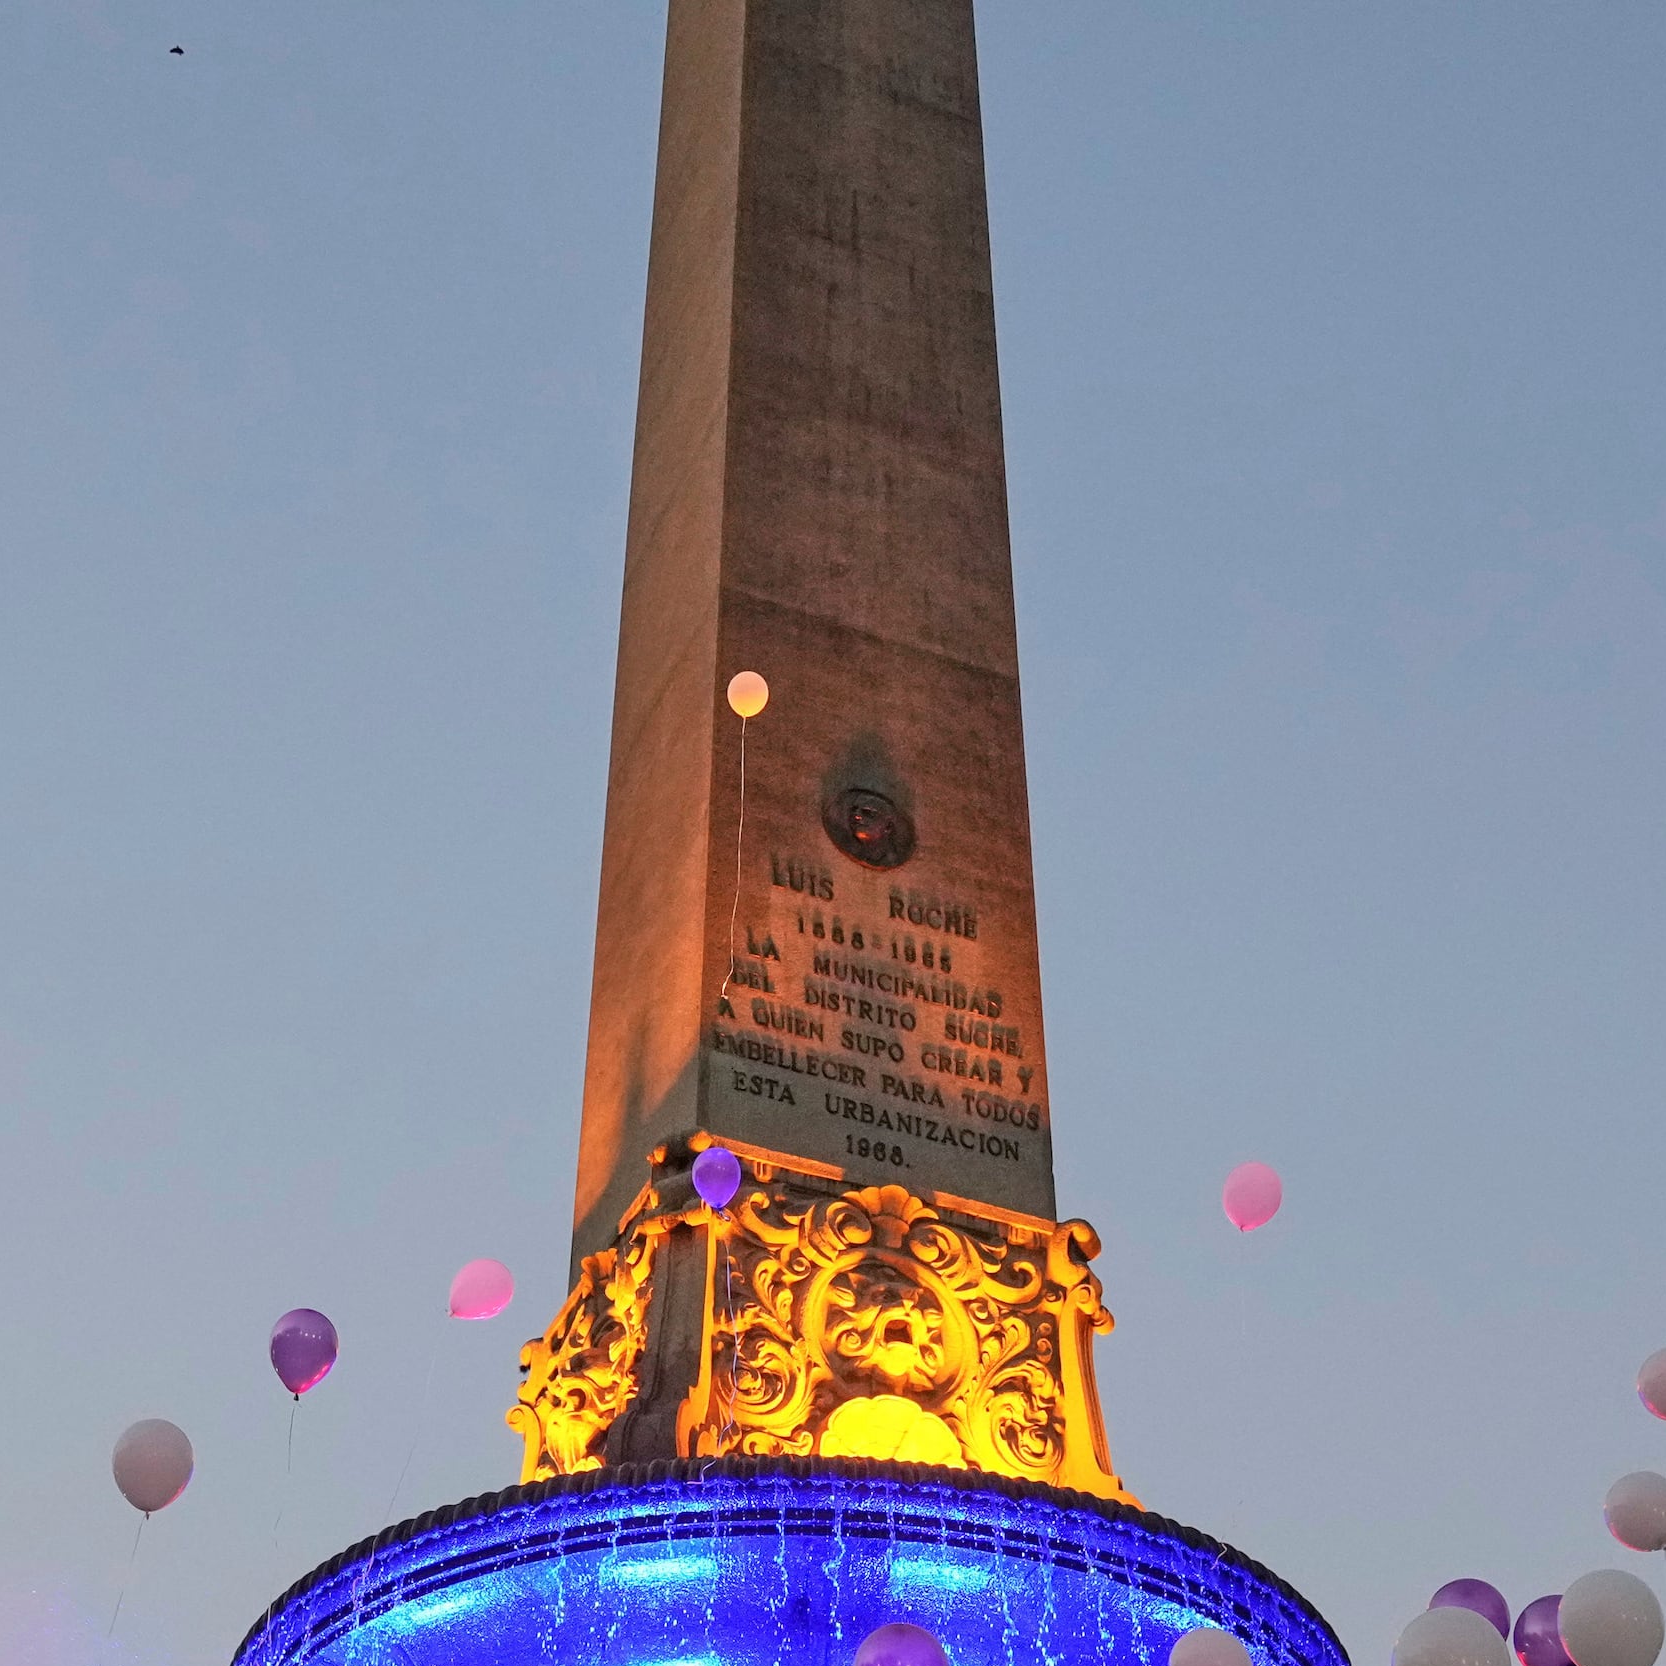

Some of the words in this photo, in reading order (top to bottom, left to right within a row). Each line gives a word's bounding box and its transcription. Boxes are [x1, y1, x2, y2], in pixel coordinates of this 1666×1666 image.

[770, 859, 834, 900] LUIS
[889, 889, 978, 939] ROCHE
[732, 965, 775, 994] DEL
[804, 982, 917, 1032] DISTRITO
[747, 927, 780, 961] LA
[813, 952, 1002, 1018] MUNICIPALIDAD
[712, 1029, 867, 1088] EMBELLECER
[881, 1072, 946, 1109] PARA
[961, 1090, 1041, 1131] TODOS
[752, 1001, 824, 1042] QUIEN
[841, 1026, 905, 1064] SUPO
[921, 1047, 1004, 1087] CREAR
[1017, 1066, 1034, 1095] Y
[732, 1069, 797, 1106] ESTA
[824, 1093, 1021, 1162] URBANIZACION
